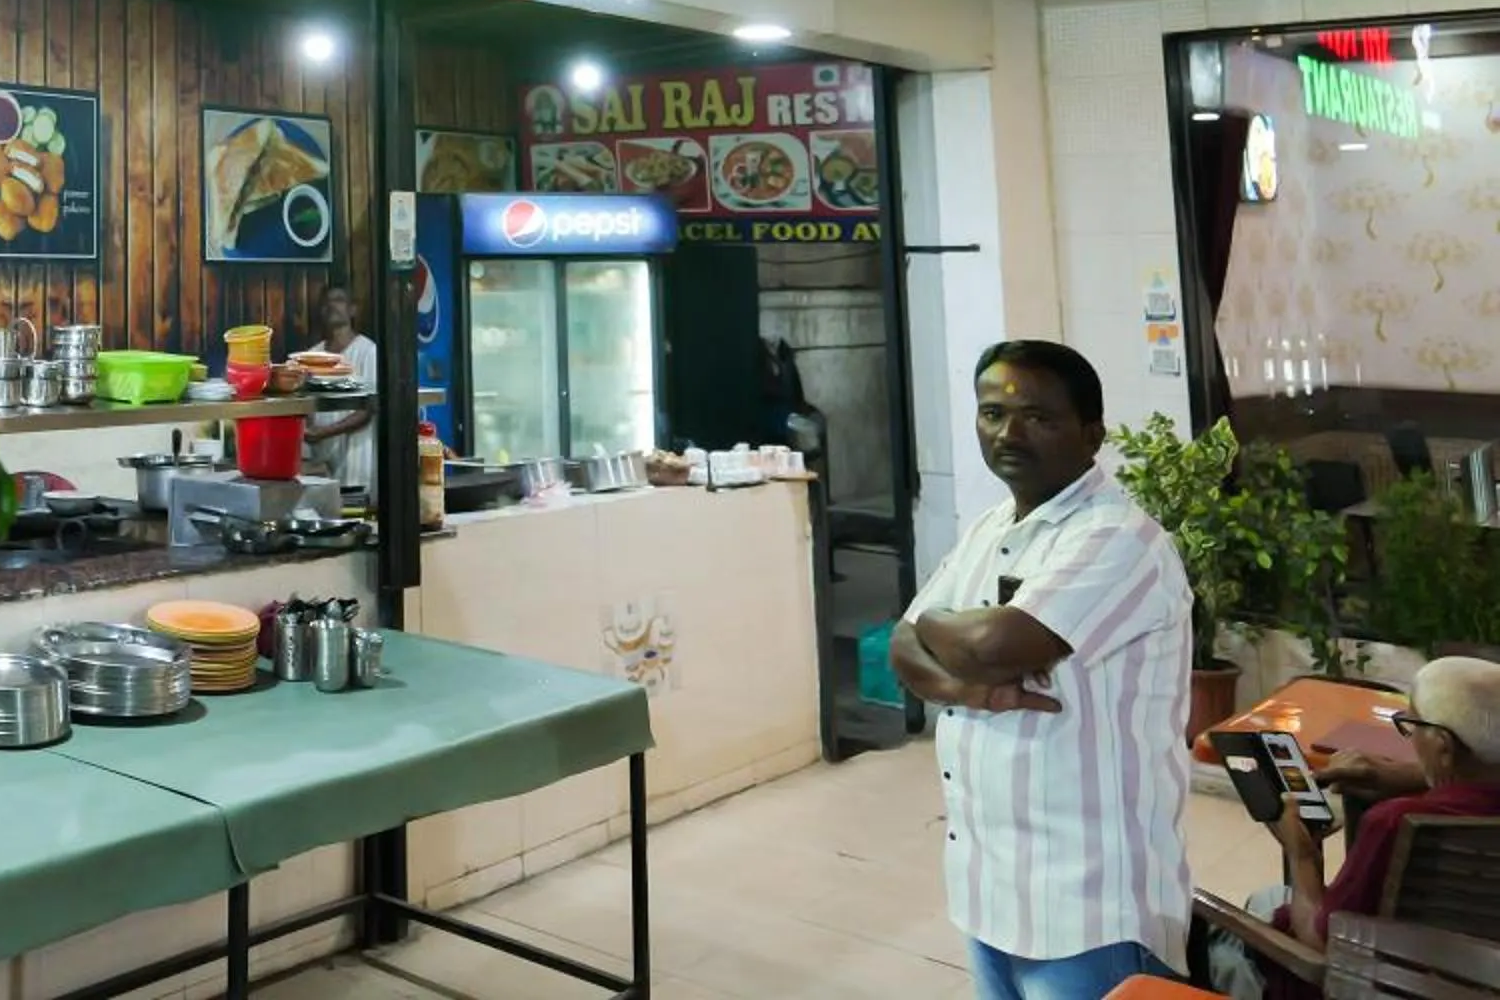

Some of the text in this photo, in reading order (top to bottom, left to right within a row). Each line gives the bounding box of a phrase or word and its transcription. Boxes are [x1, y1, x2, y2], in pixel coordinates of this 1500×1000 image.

[570, 83, 647, 134] SAI
[659, 76, 757, 129] RAJ
[552, 206, 641, 242] pepsi
[675, 223, 743, 241] CEL
[752, 221, 843, 241] FOOD
